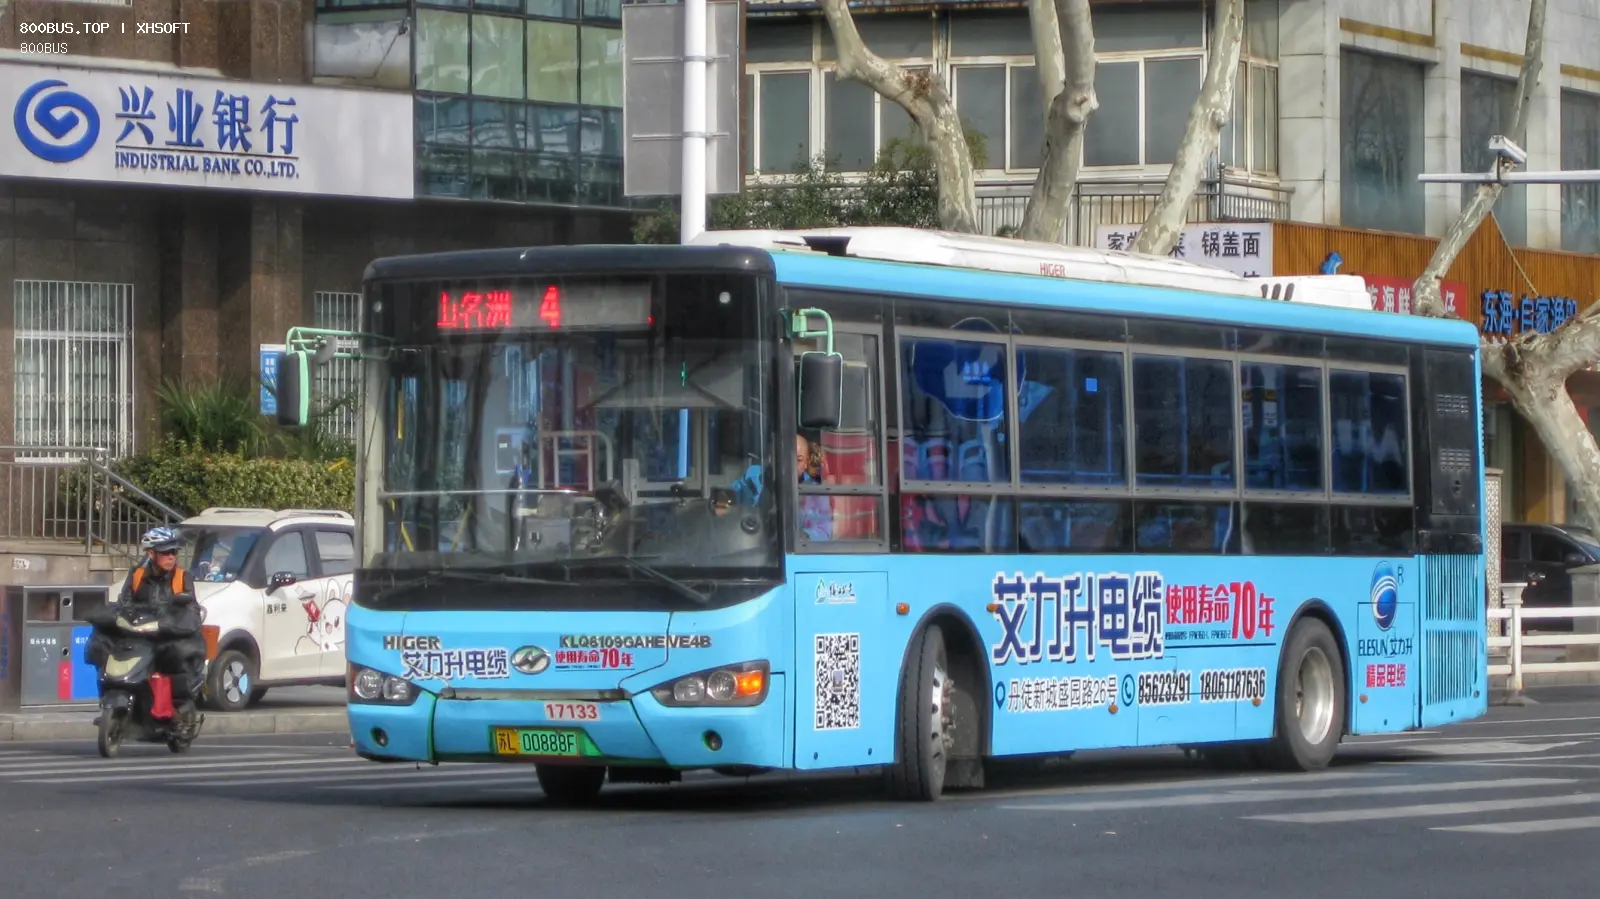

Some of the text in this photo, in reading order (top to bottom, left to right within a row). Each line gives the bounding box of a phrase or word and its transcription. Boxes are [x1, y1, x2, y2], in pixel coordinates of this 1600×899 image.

[115, 84, 299, 154] 兴业银行
[115, 151, 199, 172] INDUSTRIAL
[203, 157, 240, 175] BANK
[1107, 231, 1261, 258] 家菜 锅盖面
[1040, 262, 1065, 277] HIGER
[539, 284, 561, 329] 4
[993, 572, 1163, 662] 艾力升电缆
[1165, 580, 1275, 639] 使用寿命70年
[383, 636, 440, 650] HIGER
[1358, 636, 1412, 657] ELESUN 艾力升
[403, 649, 509, 679] 艾力升电缆
[555, 648, 634, 669] 使用寿命70年
[1366, 663, 1406, 688] 精品电缆
[1008, 669, 1266, 711] 丹徒新城盛园路26号 85623291 18061187636
[546, 703, 598, 719] 17133
